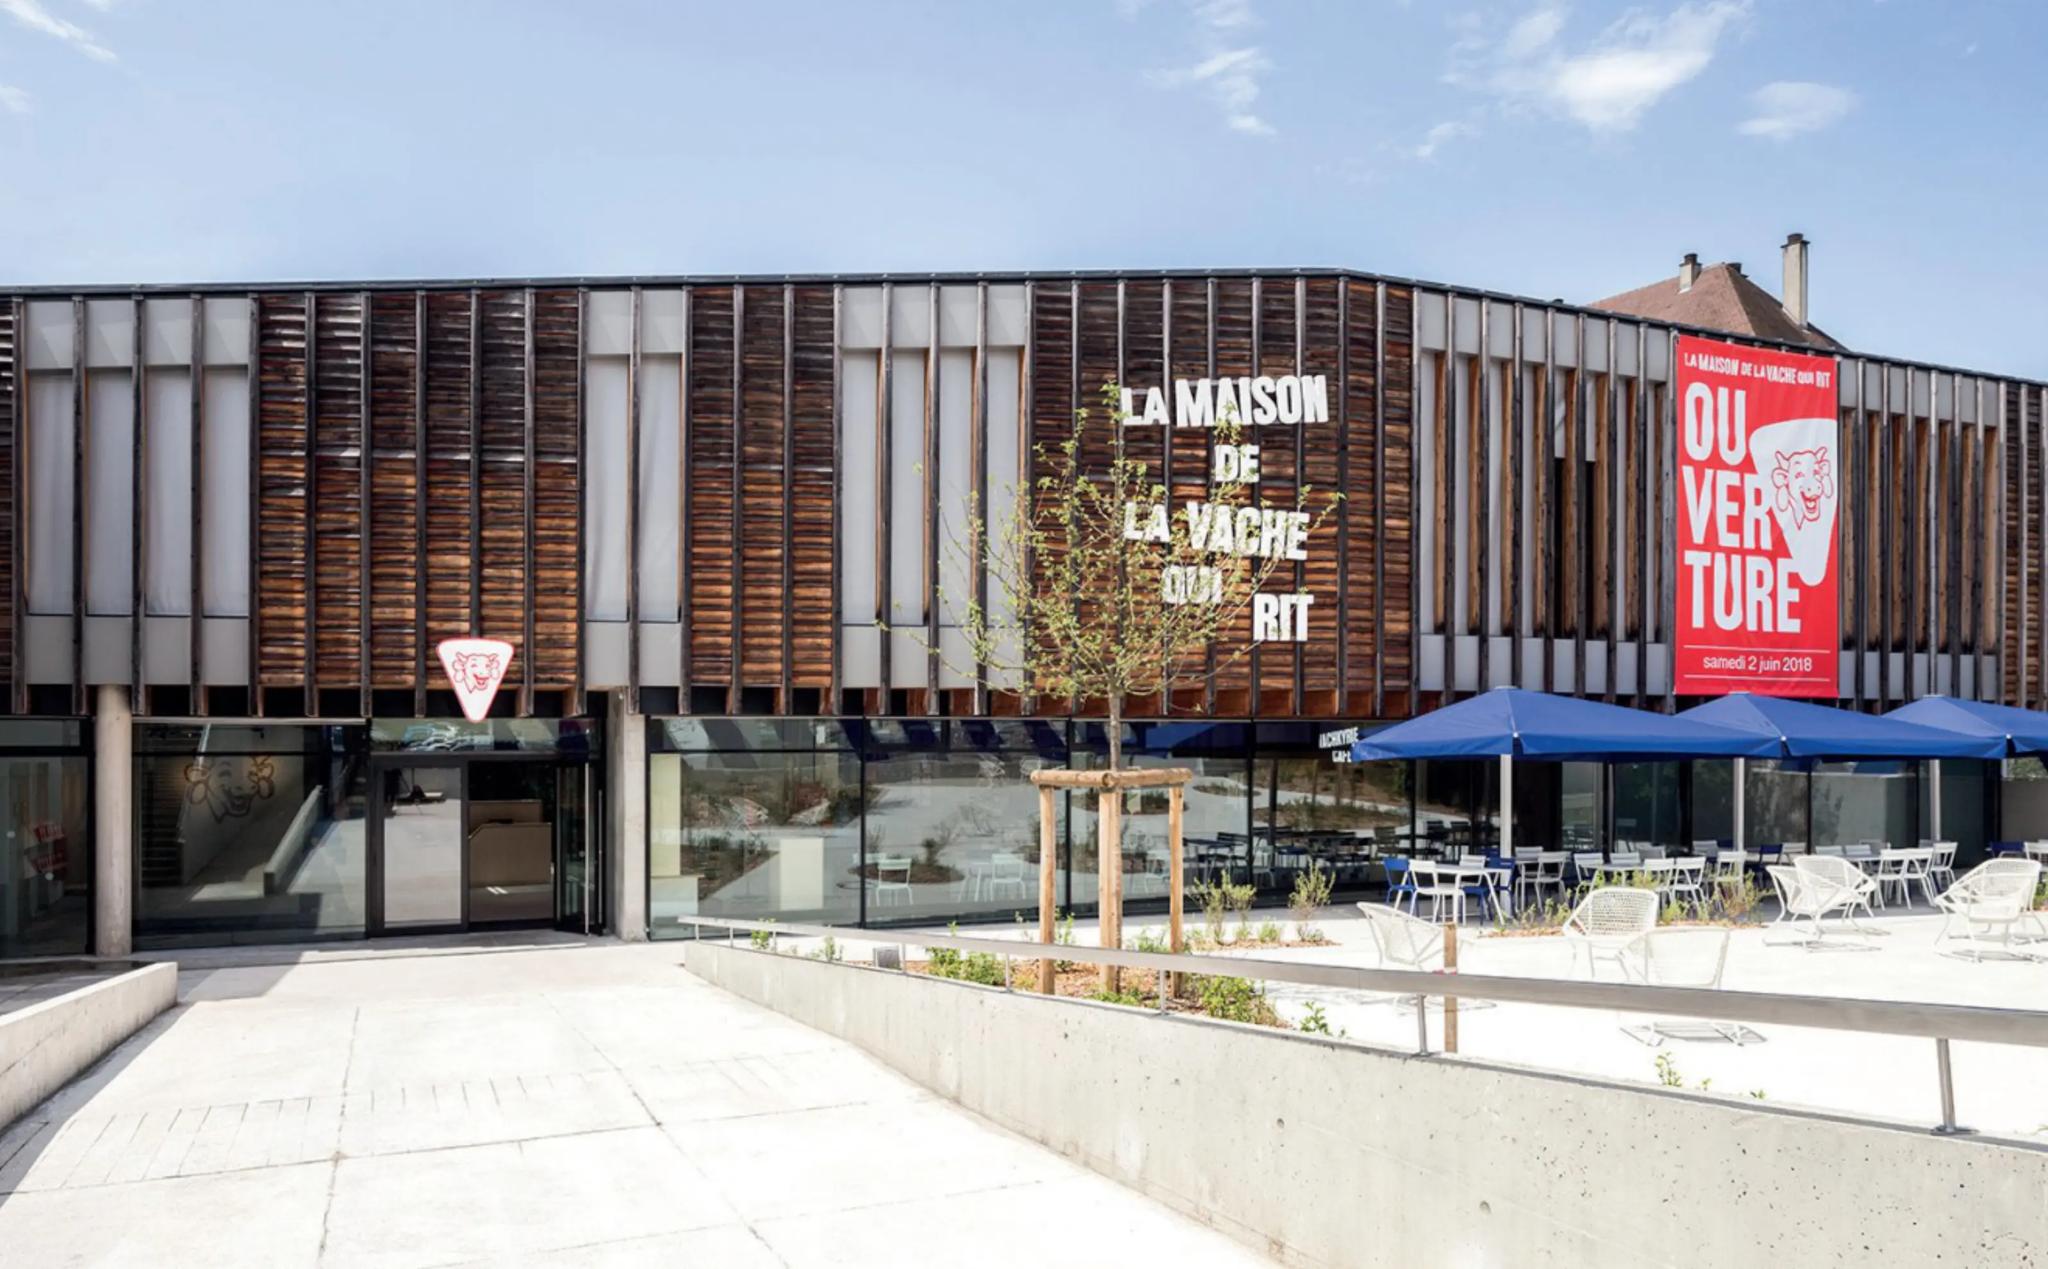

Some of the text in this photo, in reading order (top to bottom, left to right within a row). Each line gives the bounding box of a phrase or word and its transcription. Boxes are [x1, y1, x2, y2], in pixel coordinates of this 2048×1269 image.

[1684, 353, 1831, 388] LA MAISON DE LA VACHE QUI RIT
[1121, 374, 1328, 428] LA MAISON
[1684, 382, 1746, 466] OU
[1214, 444, 1260, 483] DE
[1123, 501, 1310, 560] LA VACHE
[1682, 465, 1773, 550] VER
[1253, 593, 1314, 642] RIT
[1684, 550, 1801, 634] TURE
[1703, 655, 1812, 674] samedi 2 juin 2018
